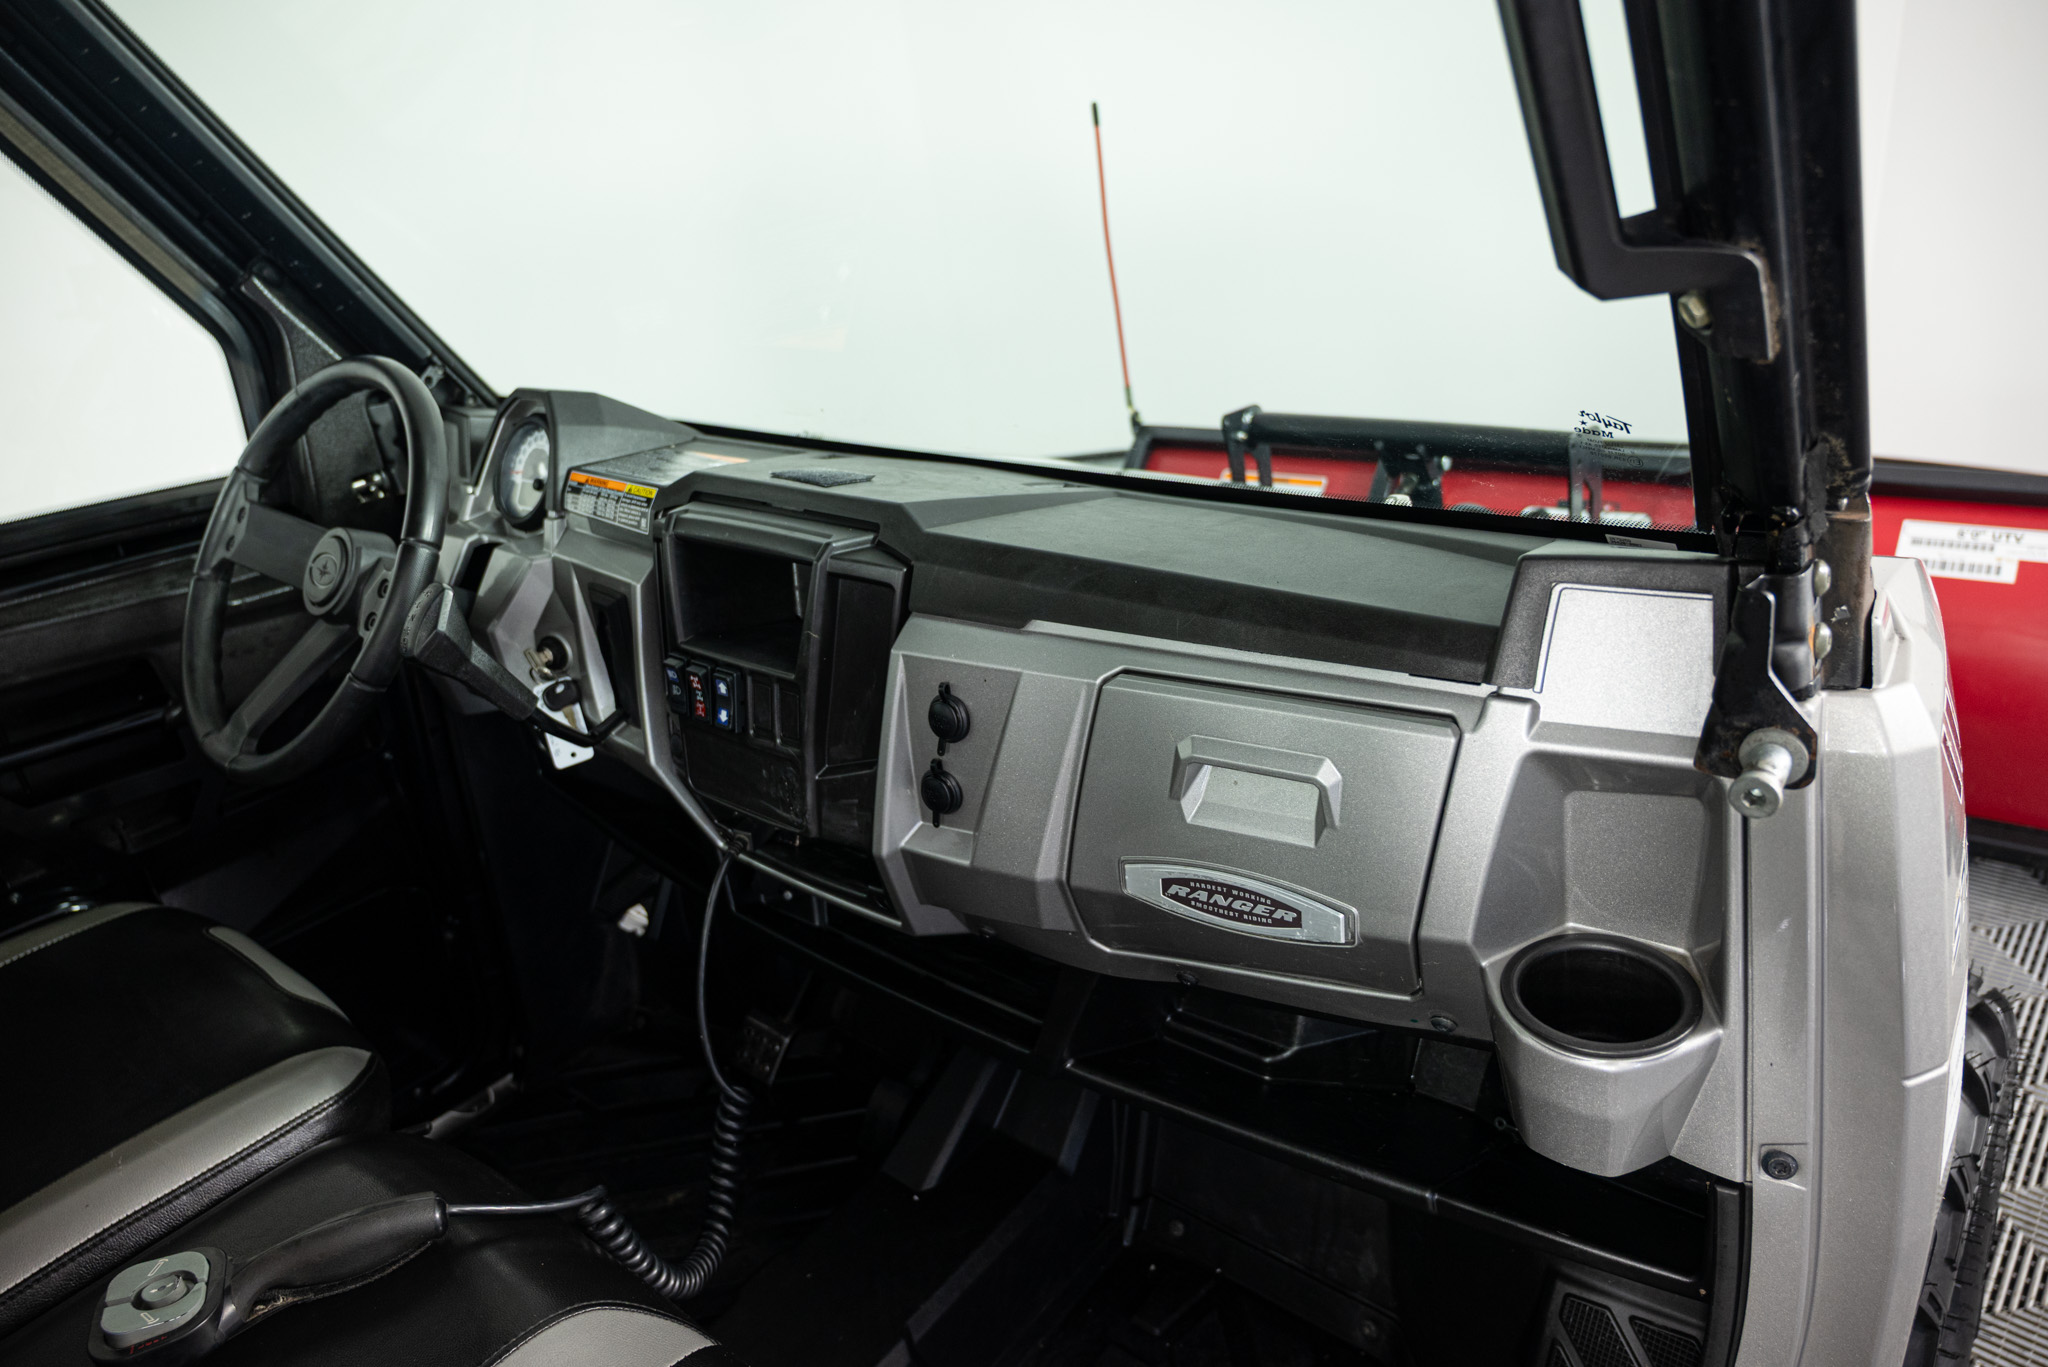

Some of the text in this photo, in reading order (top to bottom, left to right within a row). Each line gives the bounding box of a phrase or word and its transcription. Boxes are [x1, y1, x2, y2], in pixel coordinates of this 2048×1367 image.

[633, 486, 653, 496] CAUTION
[1992, 531, 2024, 543] UTV
[1166, 884, 1298, 922] RANGER
[1190, 881, 1272, 905] HARDEST WORKING
[1190, 900, 1273, 924] SMOOTHEST RIDING
